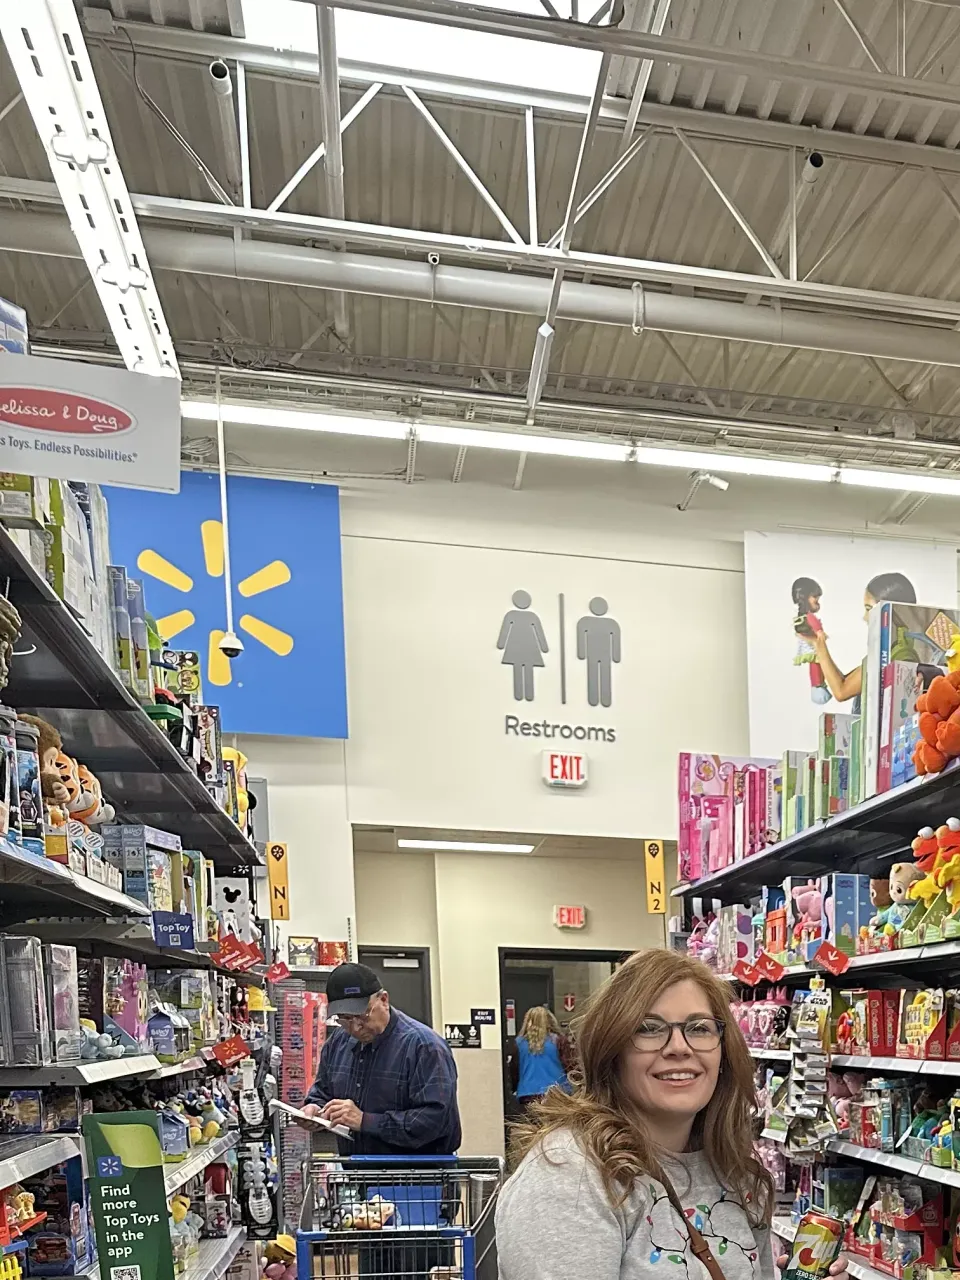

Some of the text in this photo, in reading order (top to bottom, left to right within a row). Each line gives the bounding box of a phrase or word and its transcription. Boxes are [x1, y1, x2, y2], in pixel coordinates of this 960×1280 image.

[0, 399, 118, 432] elissa & Doug
[9, 435, 32, 450] Toys.
[34, 439, 72, 455] Endless
[504, 714, 617, 743] Restrooms
[550, 754, 582, 780] EXIT
[273, 885, 286, 900] N
[650, 882, 662, 895] N
[278, 904, 284, 917] 1
[652, 899, 661, 911] 2
[559, 906, 583, 925] EXIT
[158, 923, 191, 933] Top Toy
[101, 1184, 131, 1198] Find
[102, 1200, 137, 1212] more
[103, 1212, 160, 1228] Top Toys
[106, 1229, 145, 1243] in the
[107, 1245, 133, 1259] app
[795, 1269, 809, 1278] ZERO
